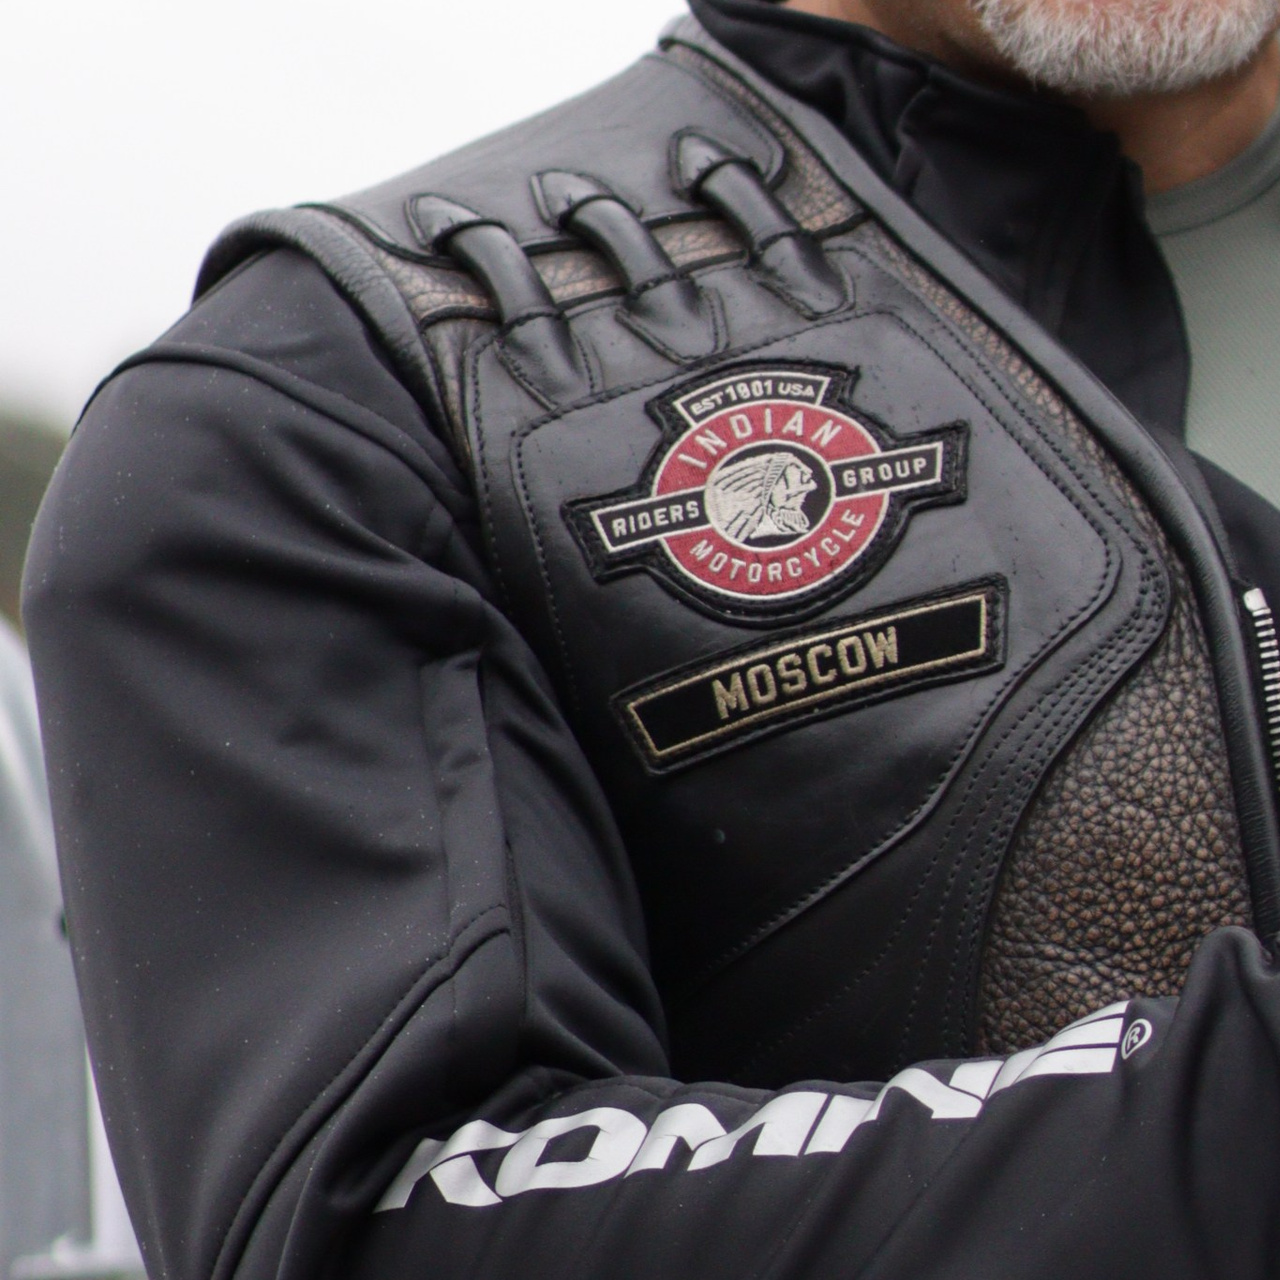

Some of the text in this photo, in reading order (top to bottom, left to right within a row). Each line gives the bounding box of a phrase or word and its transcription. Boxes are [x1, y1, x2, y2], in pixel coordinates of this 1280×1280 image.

[690, 380, 815, 416] EST 1901 USA
[679, 408, 842, 470] INDIAN
[612, 458, 928, 538] RIDERS GROUP
[689, 508, 865, 582] MOTORCYCLE
[711, 626, 899, 719] MOSCOW
